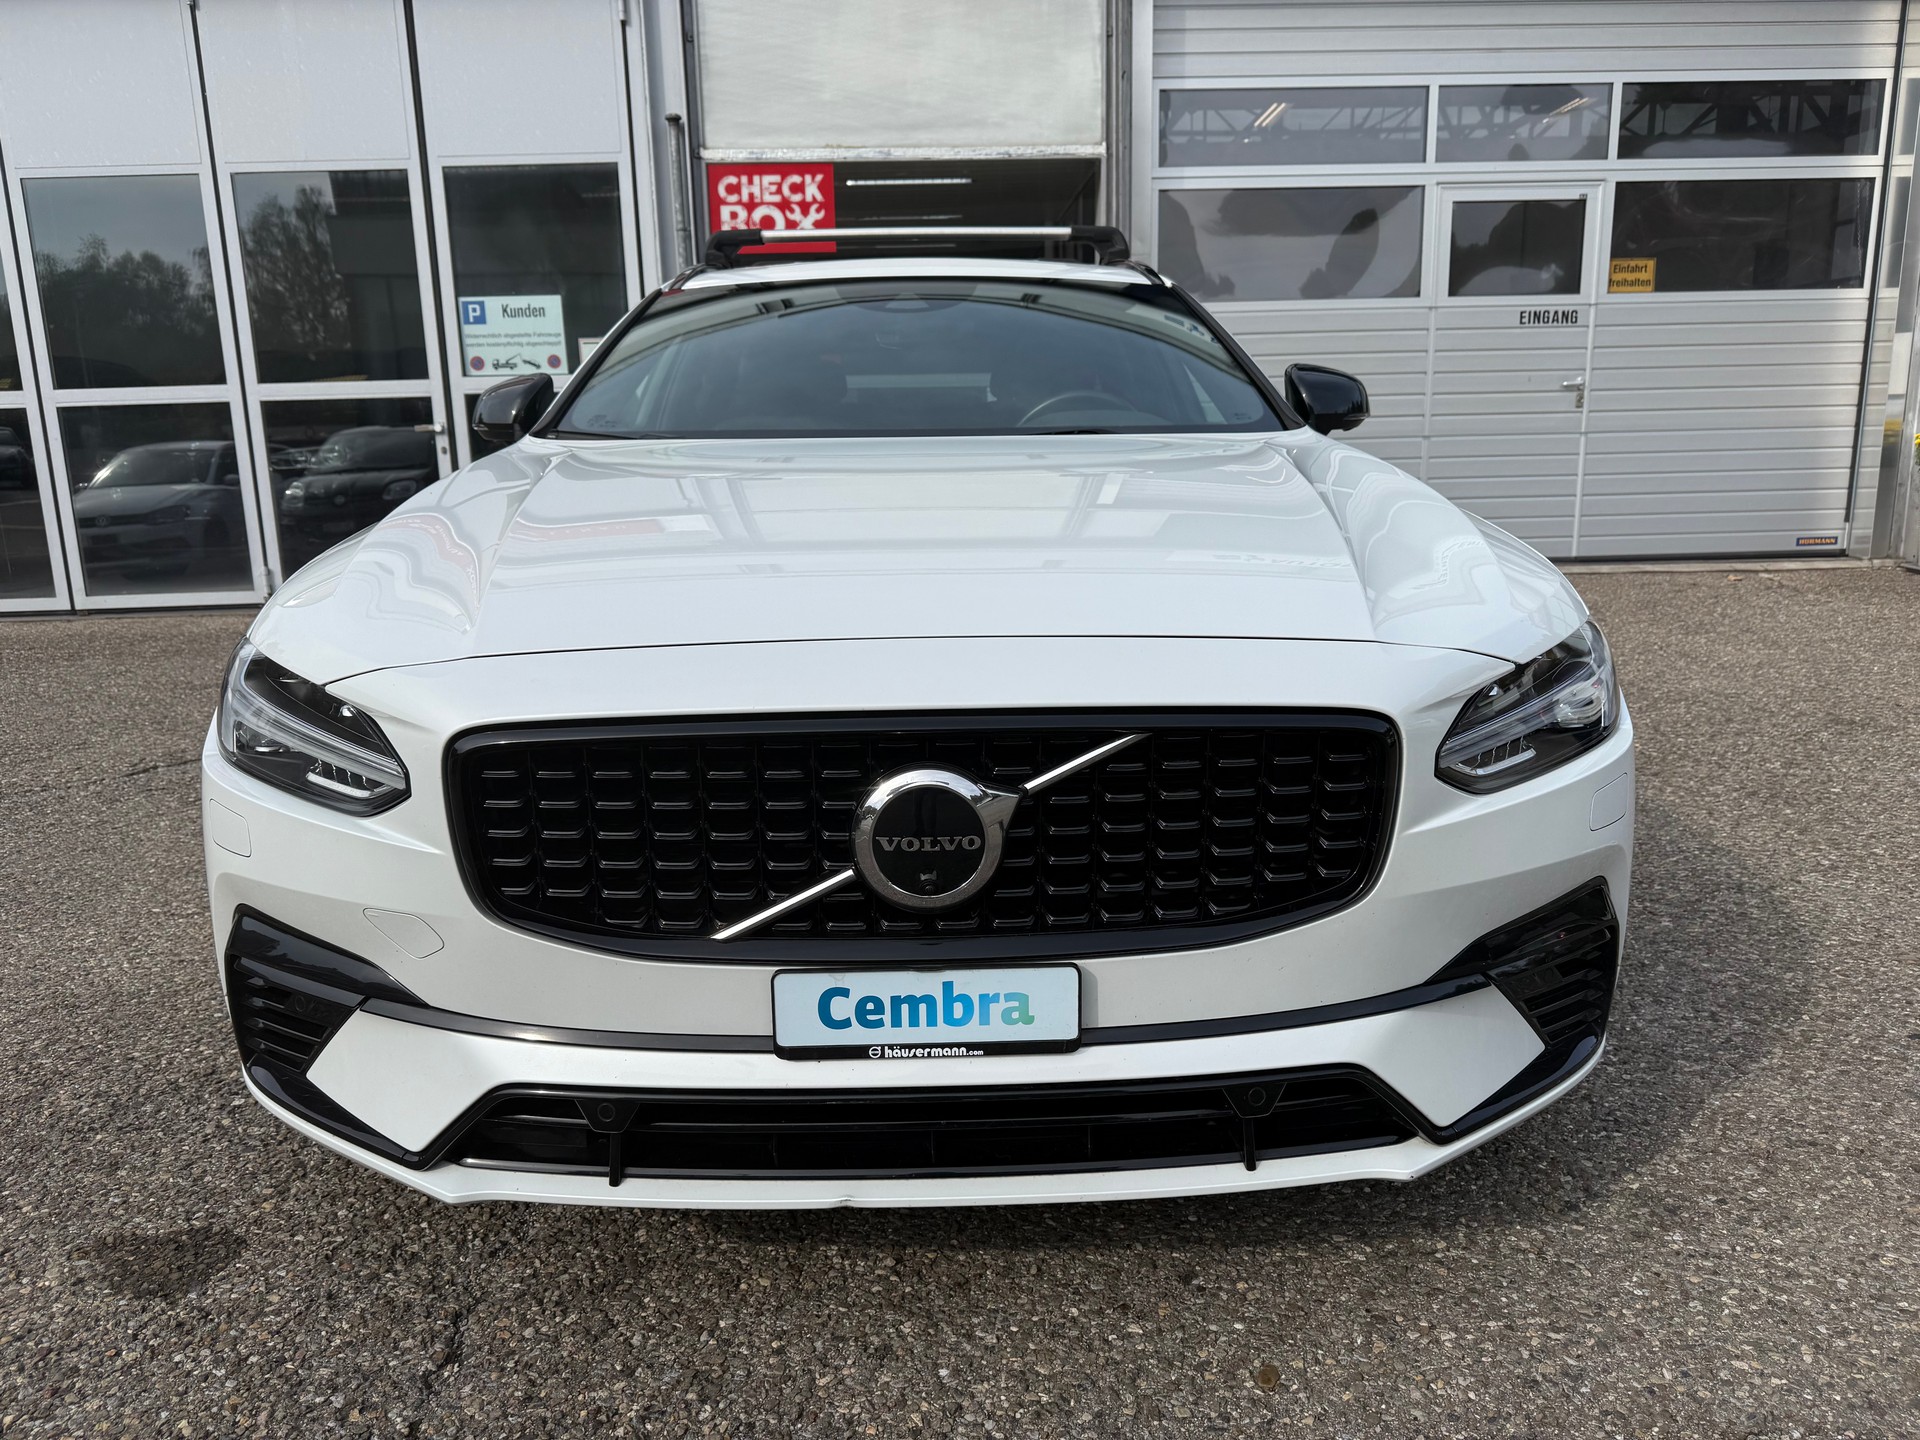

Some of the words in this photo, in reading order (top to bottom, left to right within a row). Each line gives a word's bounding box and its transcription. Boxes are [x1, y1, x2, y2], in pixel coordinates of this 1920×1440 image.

[717, 174, 825, 203] CHECK
[1613, 264, 1648, 274] Einfahrt
[467, 304, 480, 323] P
[501, 303, 546, 318] Kunden
[1519, 310, 1578, 325] EINGANG
[875, 835, 982, 852] VOLVO
[817, 980, 1034, 1030] Cembra
[884, 1045, 984, 1058] häusermann.com
